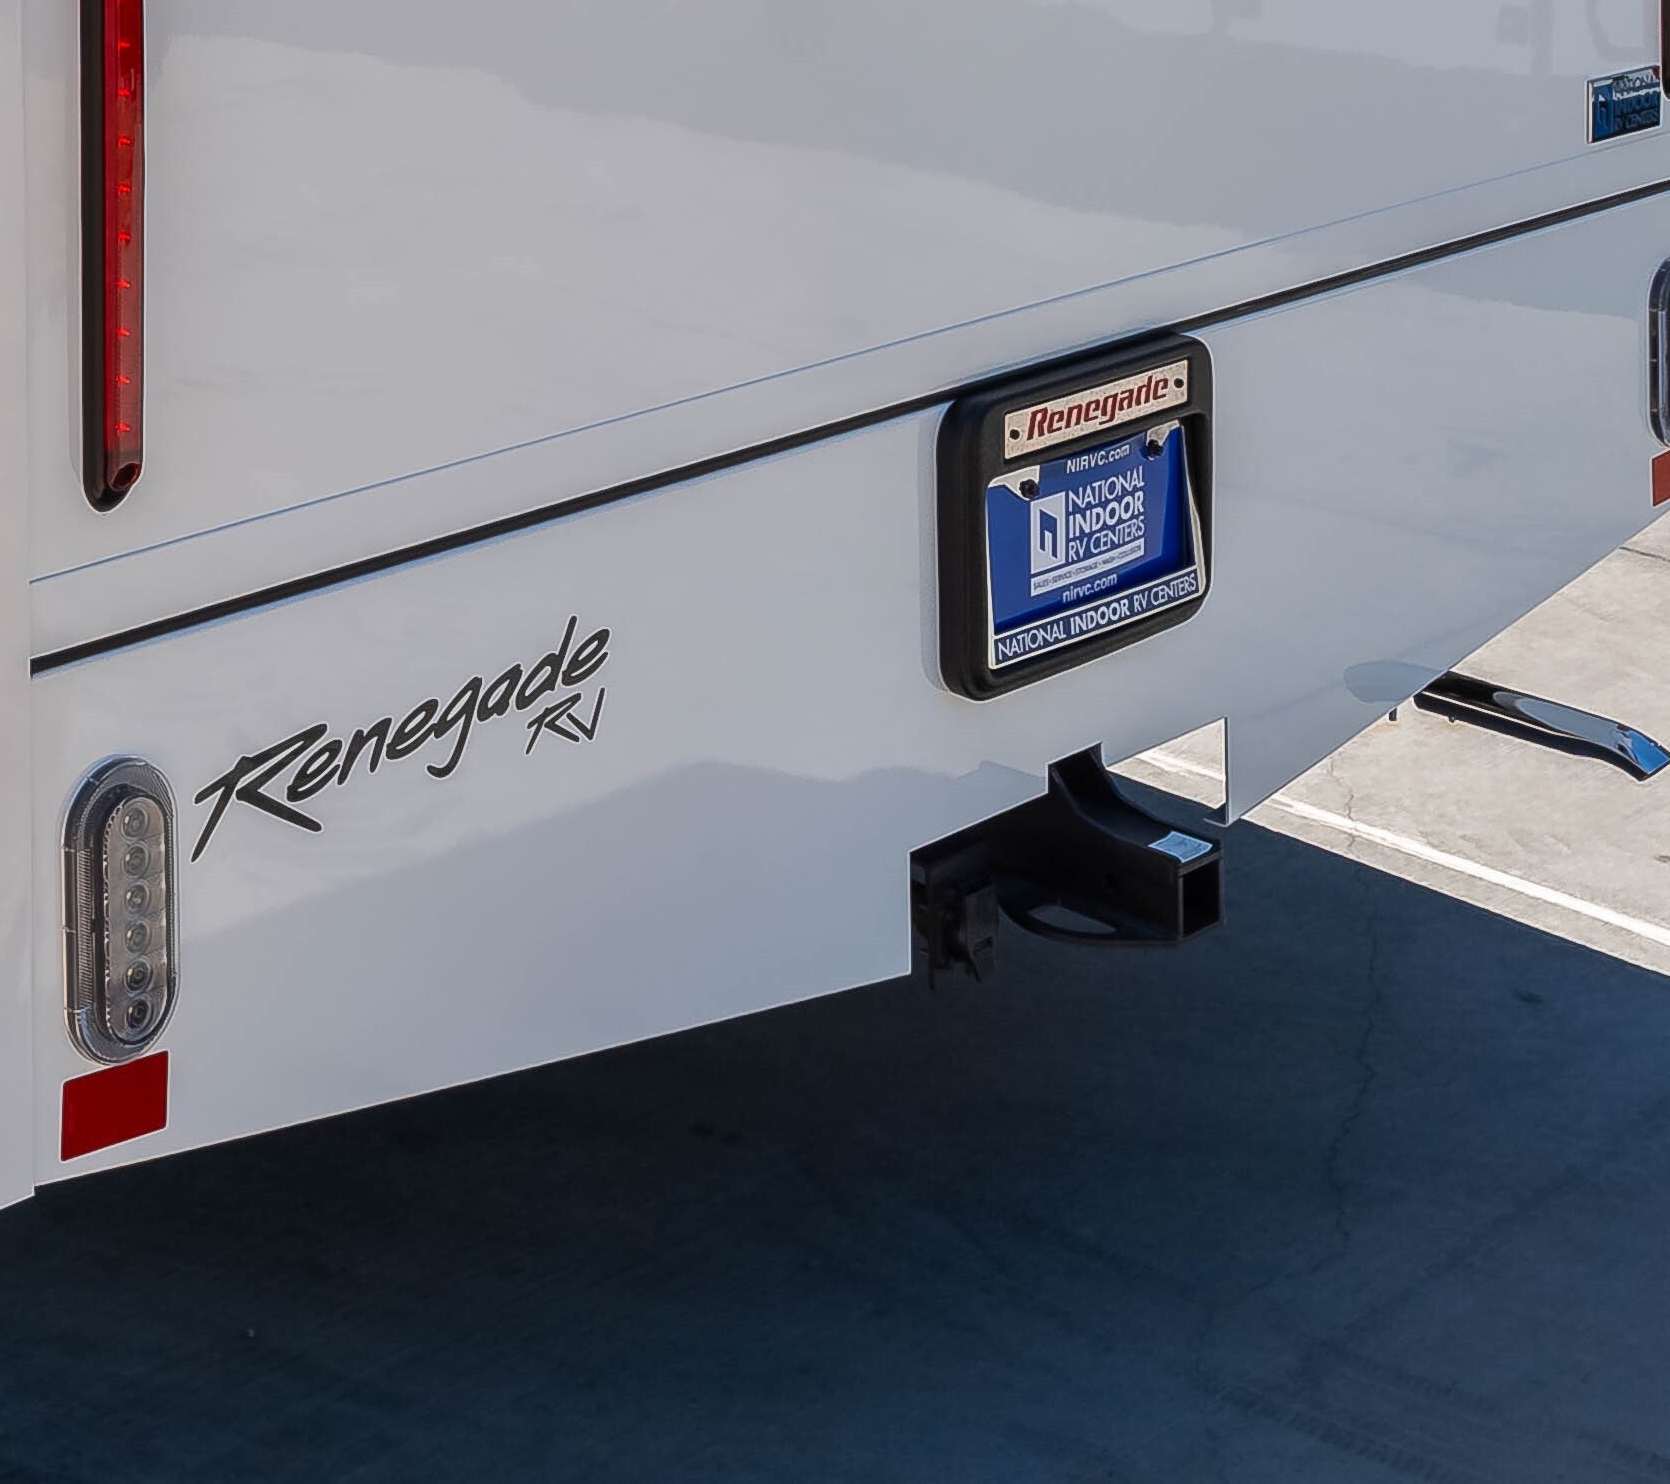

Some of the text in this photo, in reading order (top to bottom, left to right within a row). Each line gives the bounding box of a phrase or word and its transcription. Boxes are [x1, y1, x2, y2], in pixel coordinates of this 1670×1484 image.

[1026, 375, 1168, 441] Renegade
[1066, 444, 1130, 474] NIRVC.com
[1068, 466, 1145, 512] NATIONAL
[1068, 491, 1144, 539] INDOOR
[1068, 516, 1145, 563] RV CENTERS
[1062, 573, 1117, 604] nirvc.com
[998, 573, 1197, 661] NATIONAL INDOOR RV CENTERS
[192, 616, 610, 863] Renegade
[526, 688, 606, 755] RV
